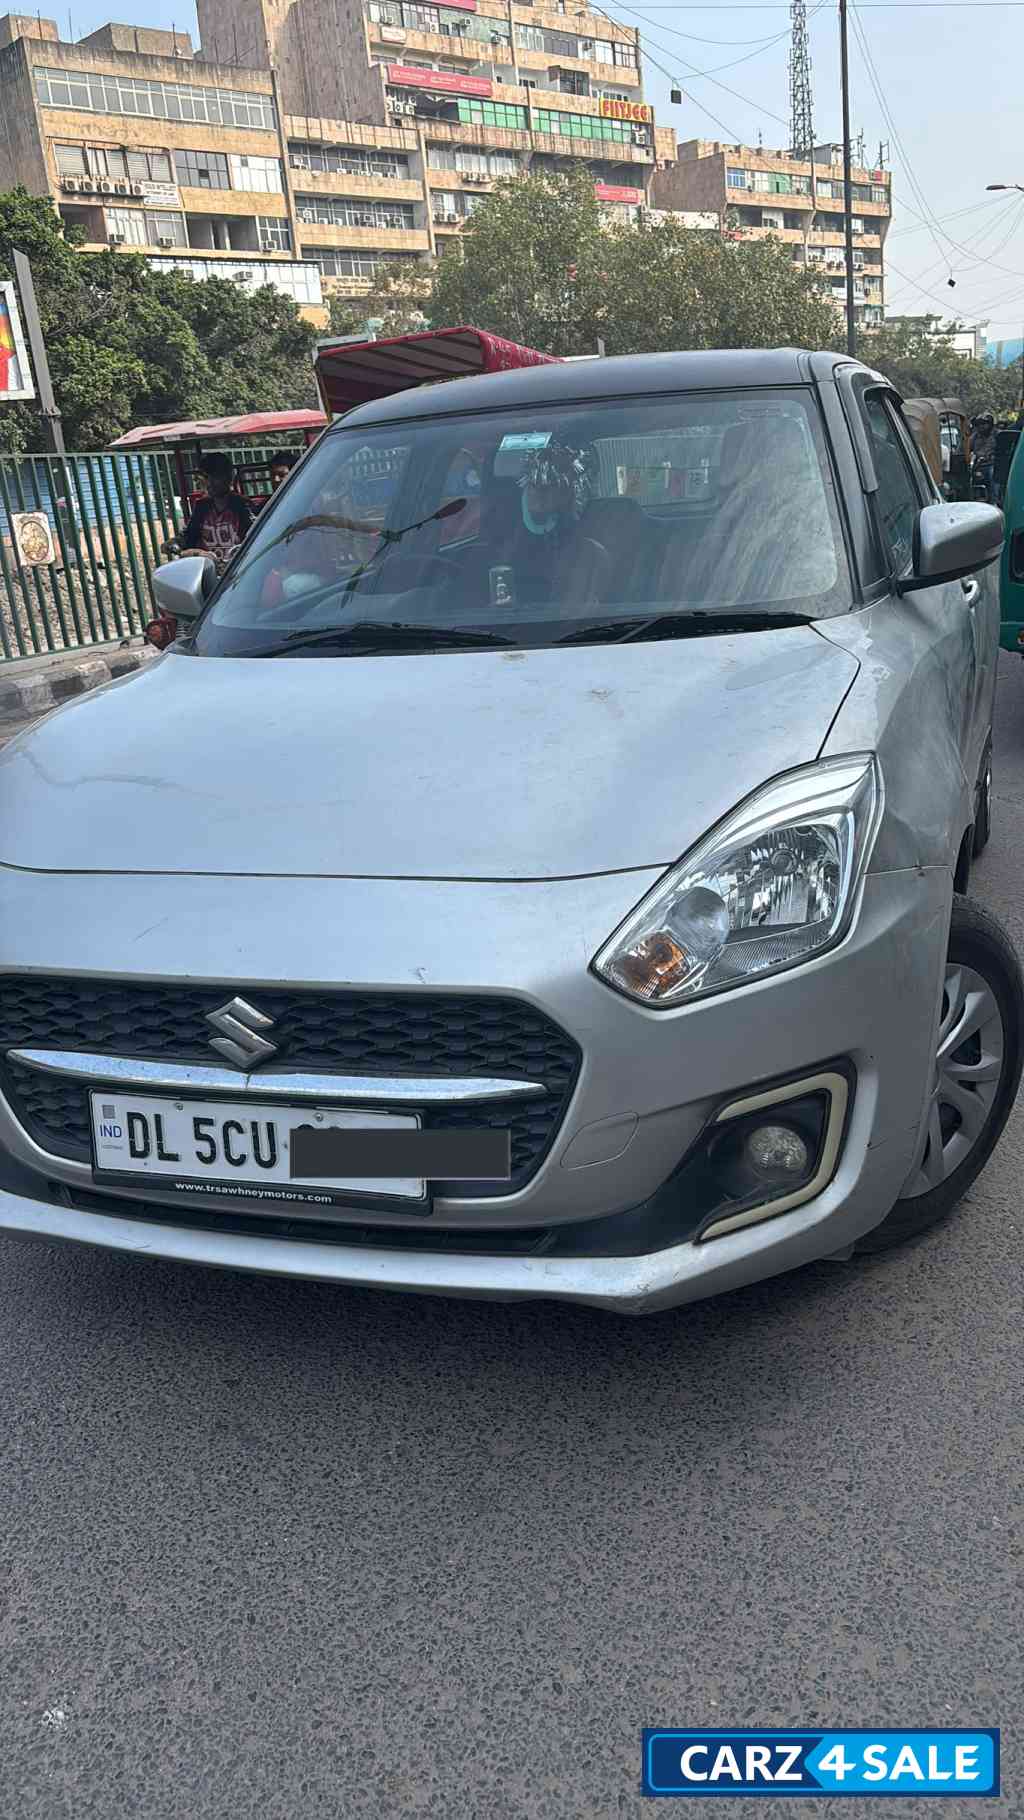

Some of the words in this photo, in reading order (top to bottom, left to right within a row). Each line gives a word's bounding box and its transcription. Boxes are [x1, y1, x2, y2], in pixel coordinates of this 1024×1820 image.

[100, 1125, 122, 1138] IND
[126, 1111, 181, 1162] DL
[192, 1116, 277, 1169] 5CU
[175, 1182, 332, 1203] www.trsawhneymotors.com
